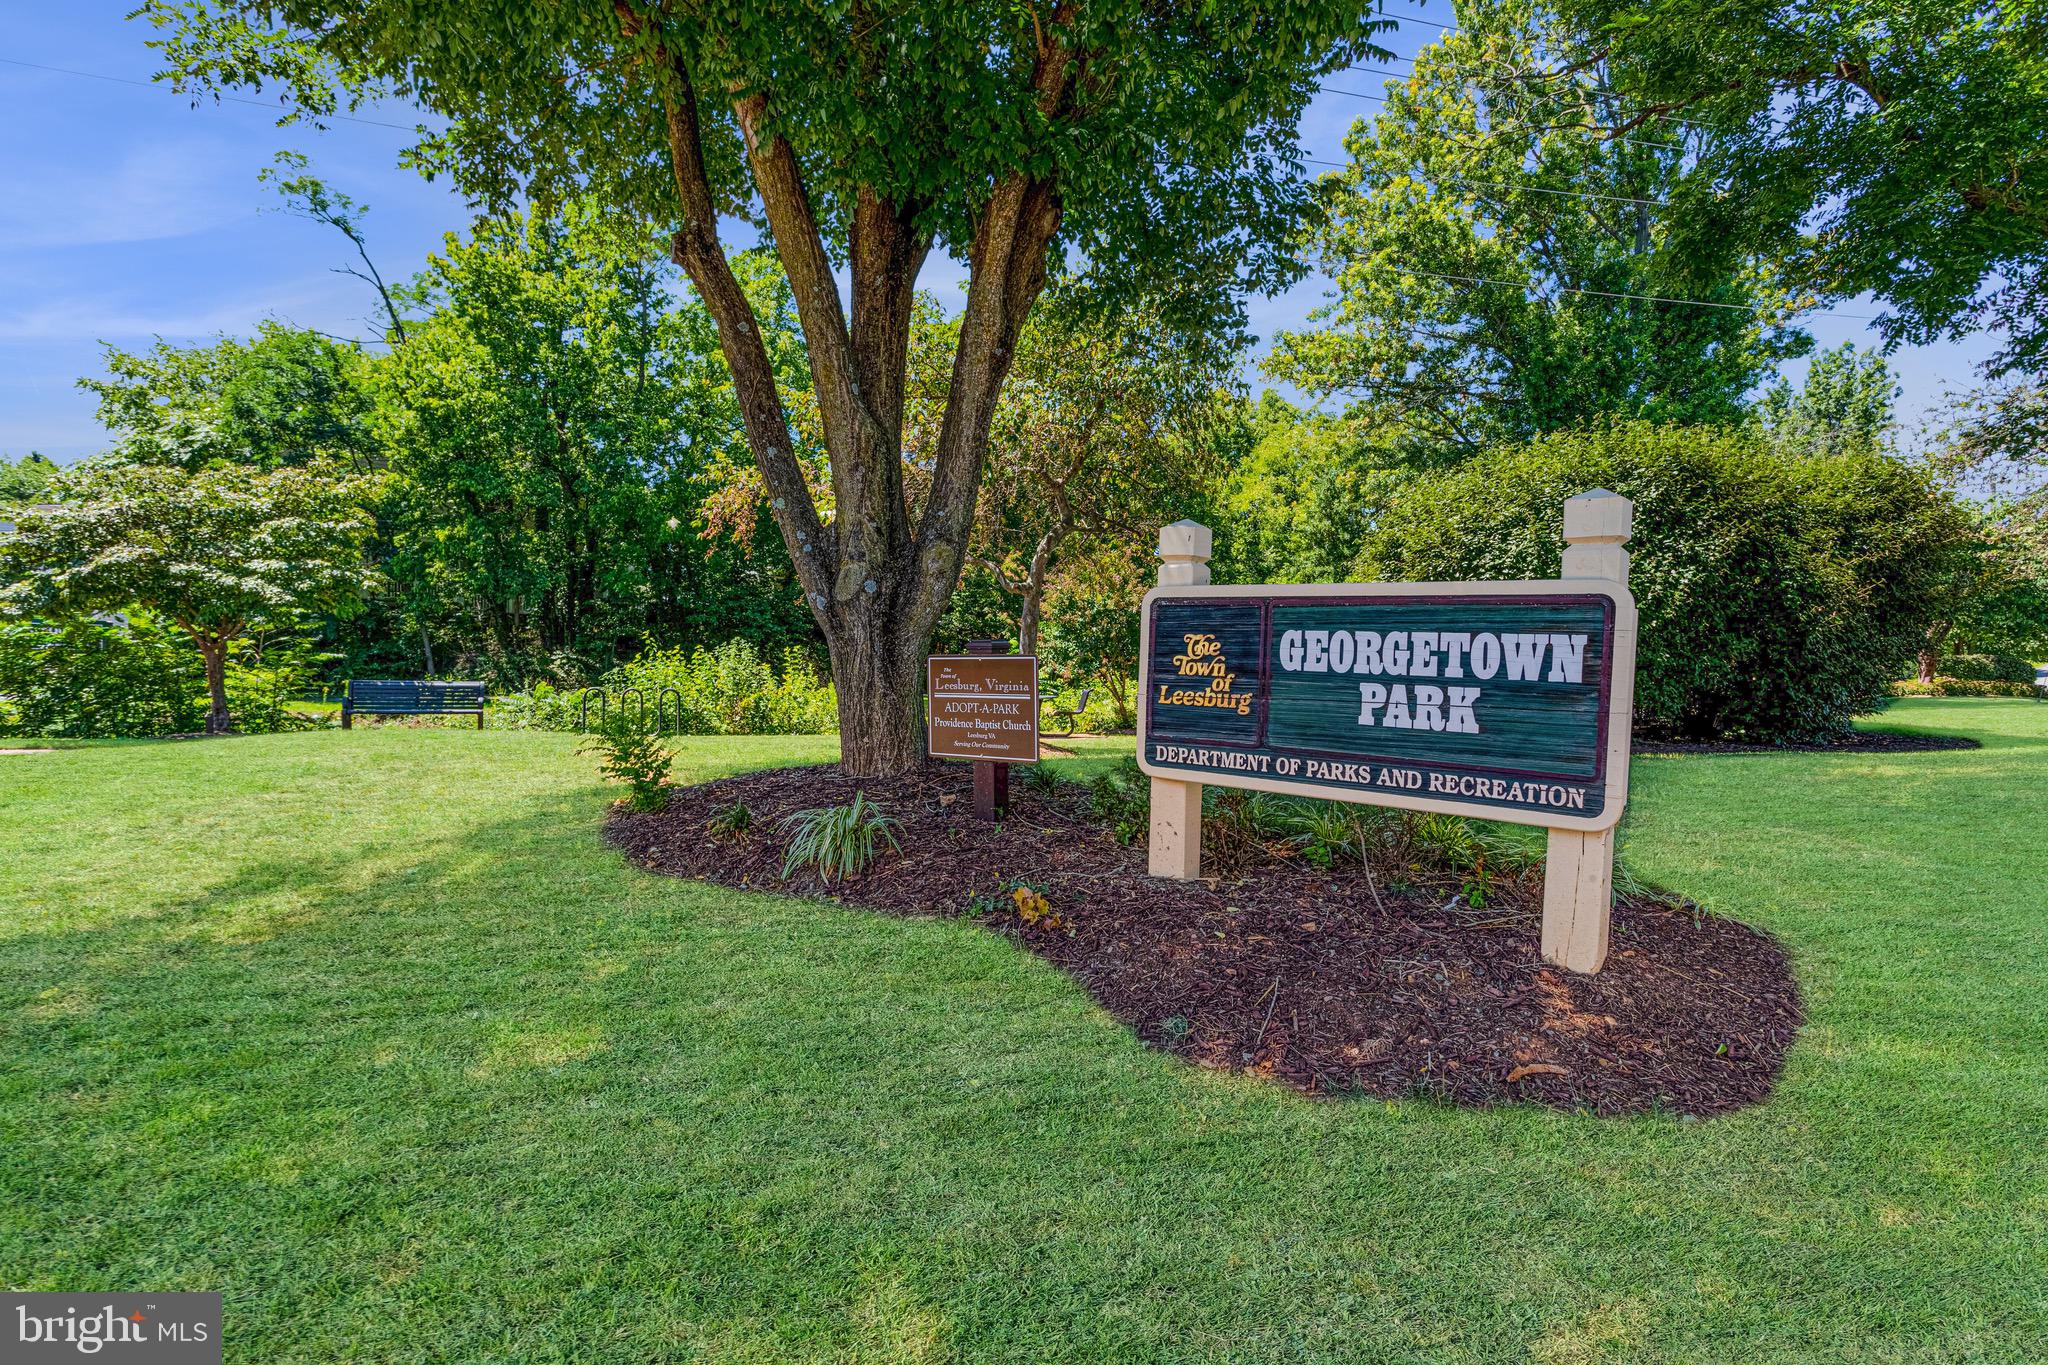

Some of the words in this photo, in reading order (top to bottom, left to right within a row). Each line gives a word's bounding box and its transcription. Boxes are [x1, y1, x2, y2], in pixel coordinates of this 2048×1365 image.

[1184, 634, 1221, 660] The
[1279, 629, 1588, 684] GEORGETOWN
[1173, 655, 1225, 677] Town
[935, 678, 982, 692] Leesburg,
[985, 679, 1030, 693] Virginia
[1211, 673, 1235, 692] of
[944, 702, 1020, 714] ADOPT-A-PARK
[1158, 685, 1253, 715] Leesburg
[1357, 682, 1481, 734] PARK
[934, 717, 973, 728] Providence
[975, 718, 1001, 730] Baptist
[1002, 720, 1031, 731] Church
[1155, 745, 1271, 772] DEPARTMENT
[1275, 757, 1301, 776] OF
[1306, 760, 1371, 784] PARKS
[1376, 767, 1422, 789] AND
[1428, 773, 1586, 809] RECREATION
